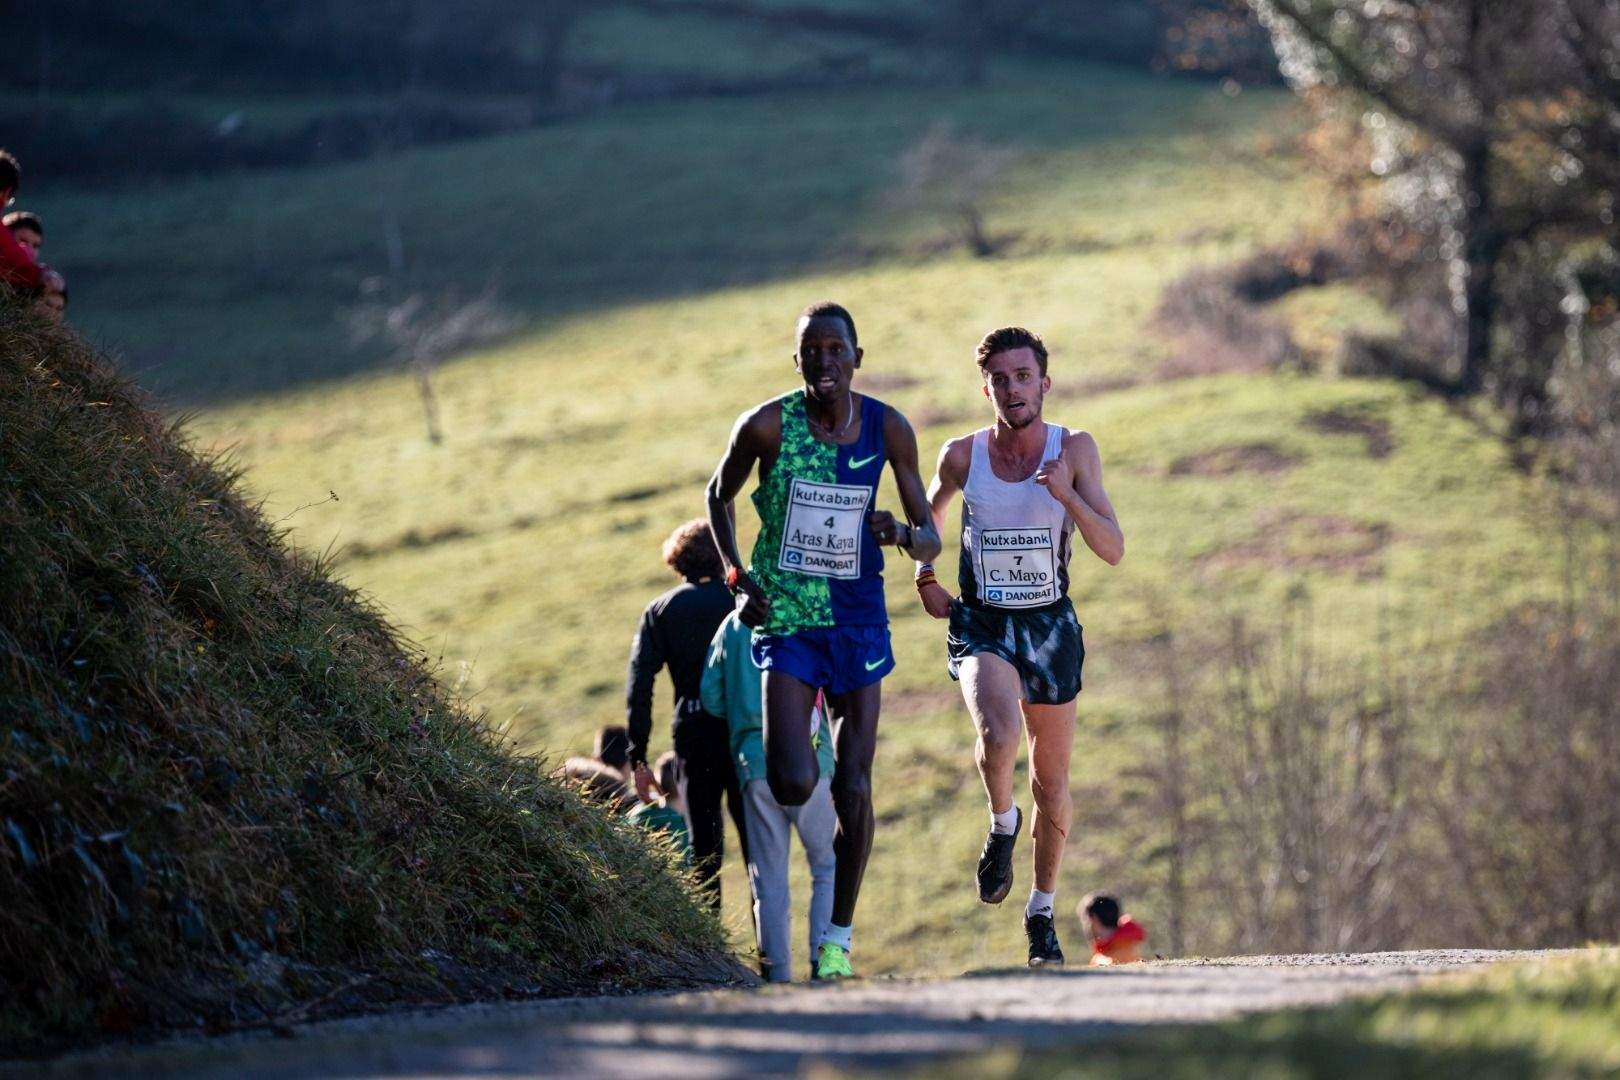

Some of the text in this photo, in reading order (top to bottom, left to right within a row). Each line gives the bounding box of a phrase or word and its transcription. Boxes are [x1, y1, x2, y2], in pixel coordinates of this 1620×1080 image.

[796, 487, 865, 505] kutxabank
[824, 516, 835, 529] 4
[791, 529, 854, 552] Aras Kaya
[983, 534, 1049, 546] kutxabank
[805, 556, 854, 570] DANOBAT
[1013, 556, 1023, 566] 7
[990, 569, 1047, 584] C. Mayo
[1005, 588, 1052, 601] DANOBAT
